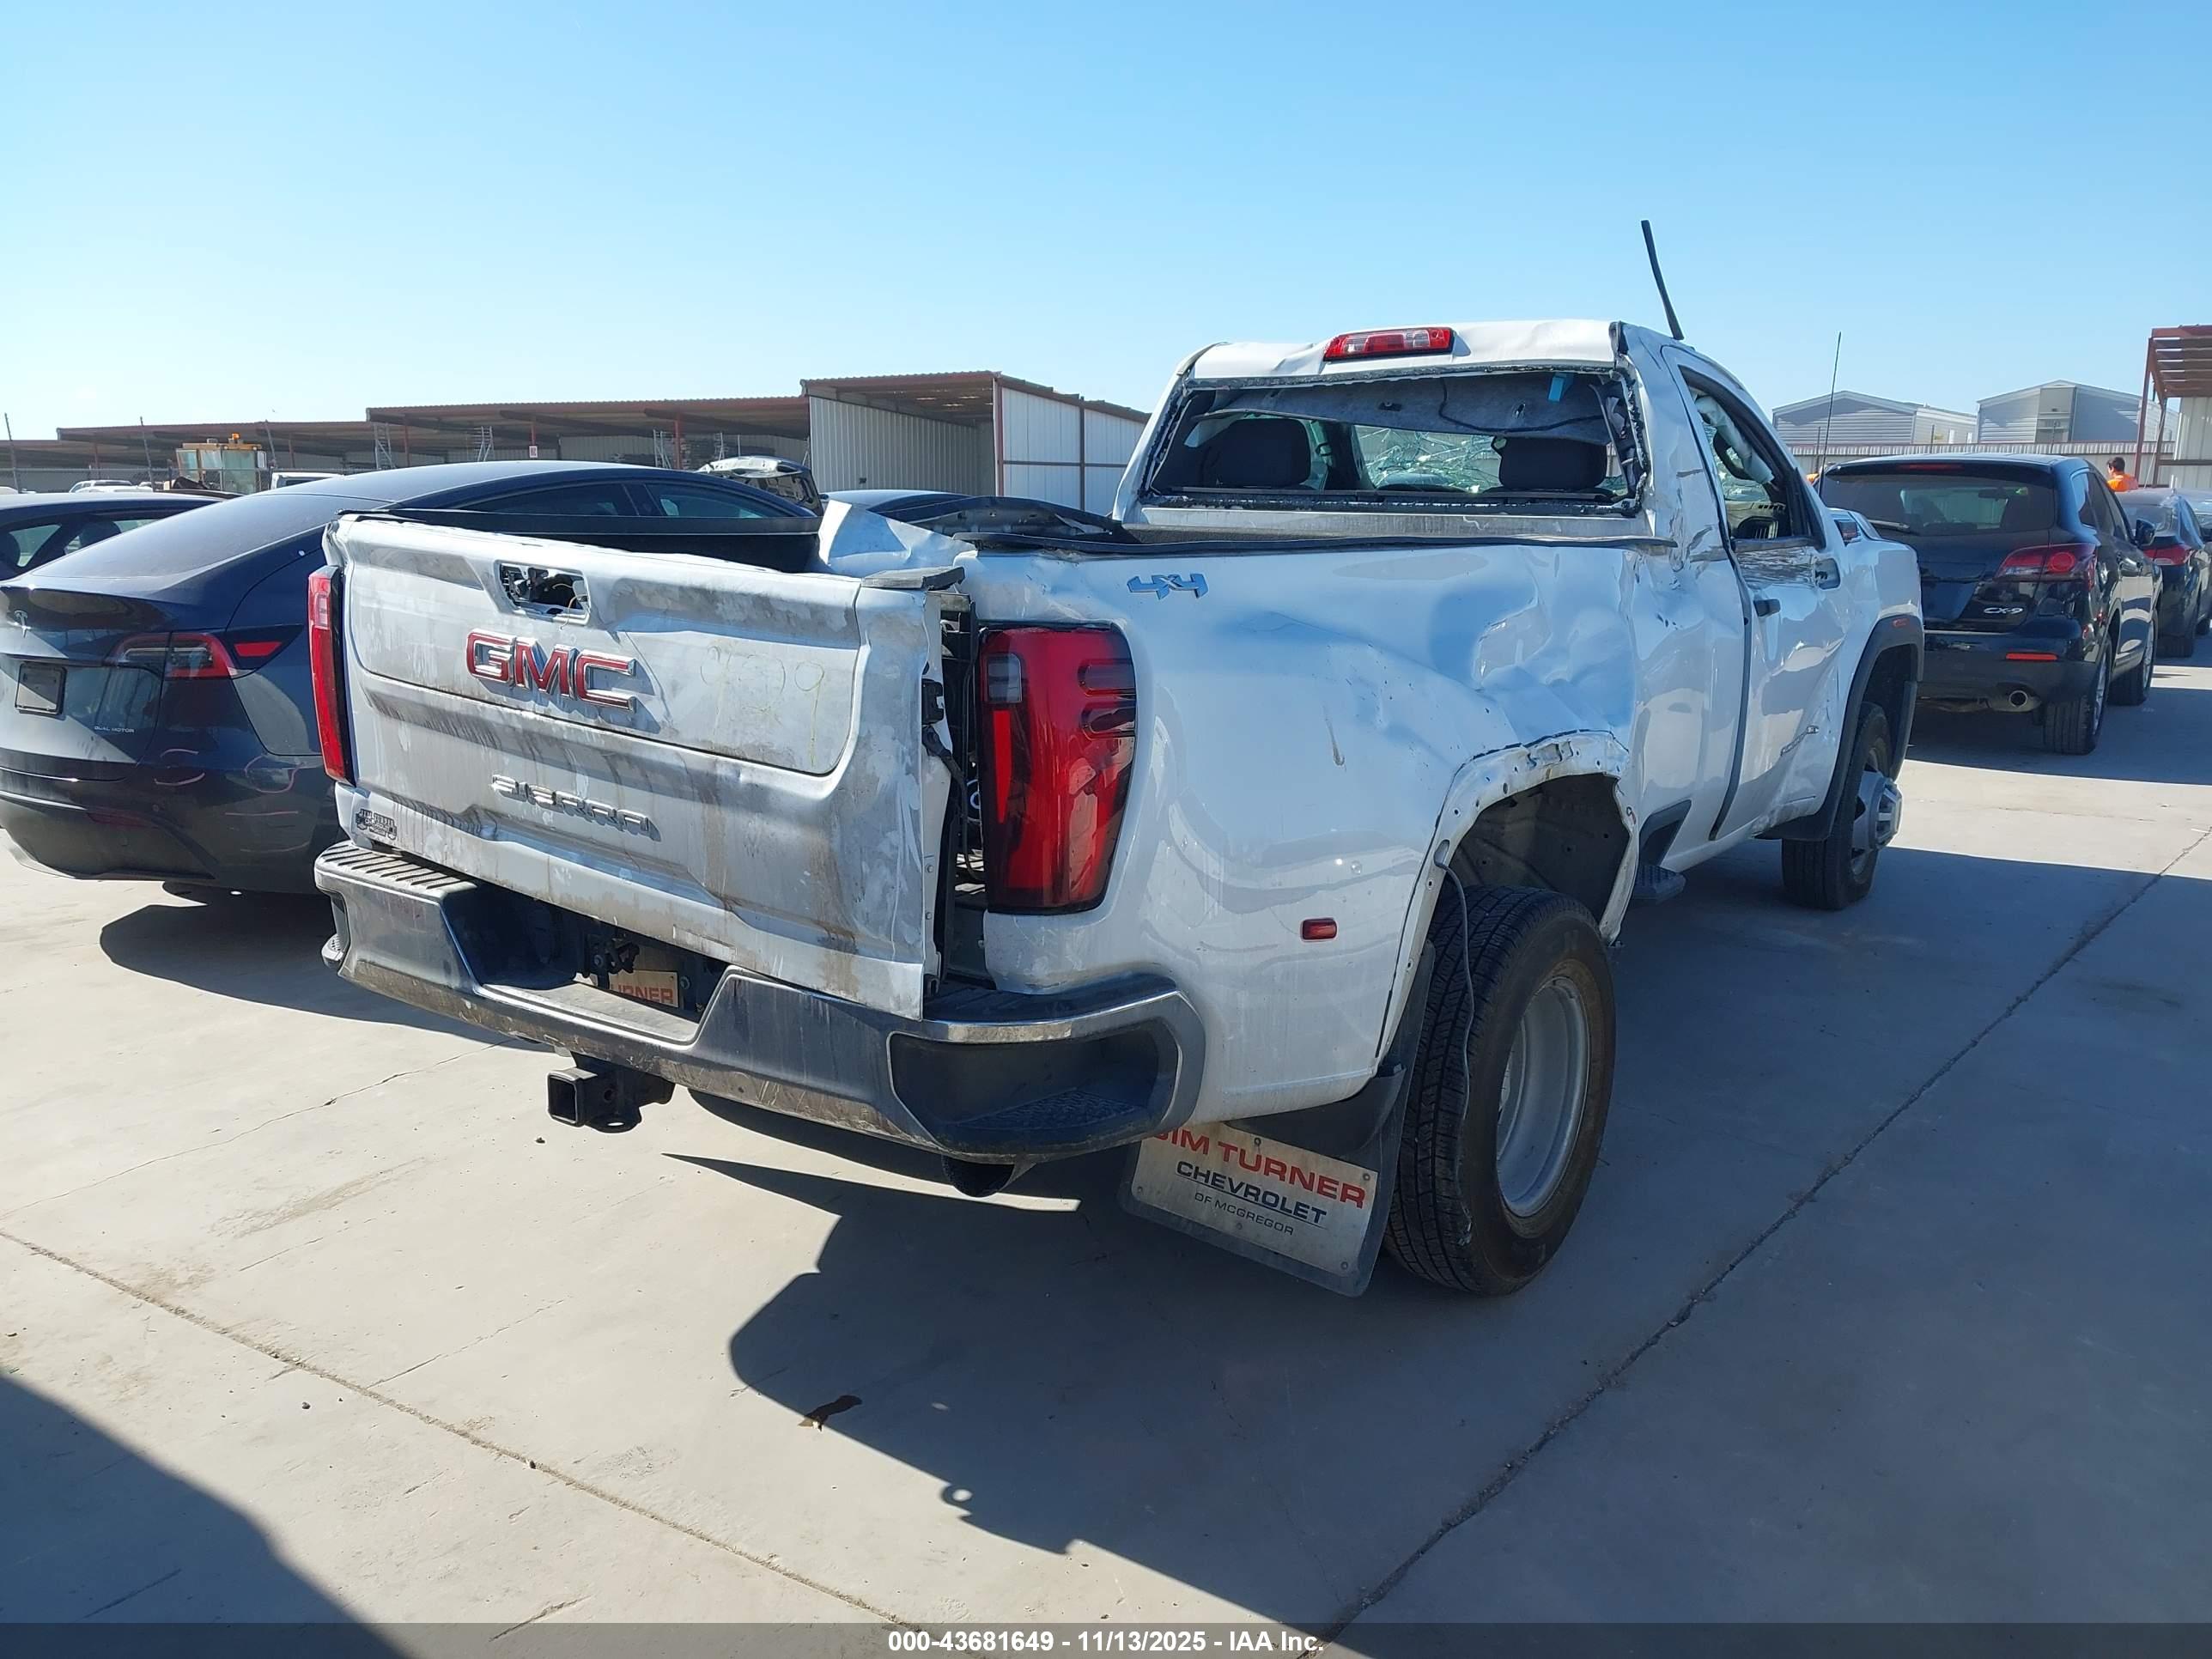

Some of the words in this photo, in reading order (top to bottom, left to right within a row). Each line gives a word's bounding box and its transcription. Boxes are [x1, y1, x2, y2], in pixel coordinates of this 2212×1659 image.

[466, 628, 637, 714] GMC
[491, 775, 650, 831] SIERRA
[1176, 1161, 1328, 1224] CHEVROLET
[1218, 1141, 1366, 1209] TURNER
[1194, 1191, 1211, 1204] OF
[1215, 1199, 1294, 1235] MCGREGOR
